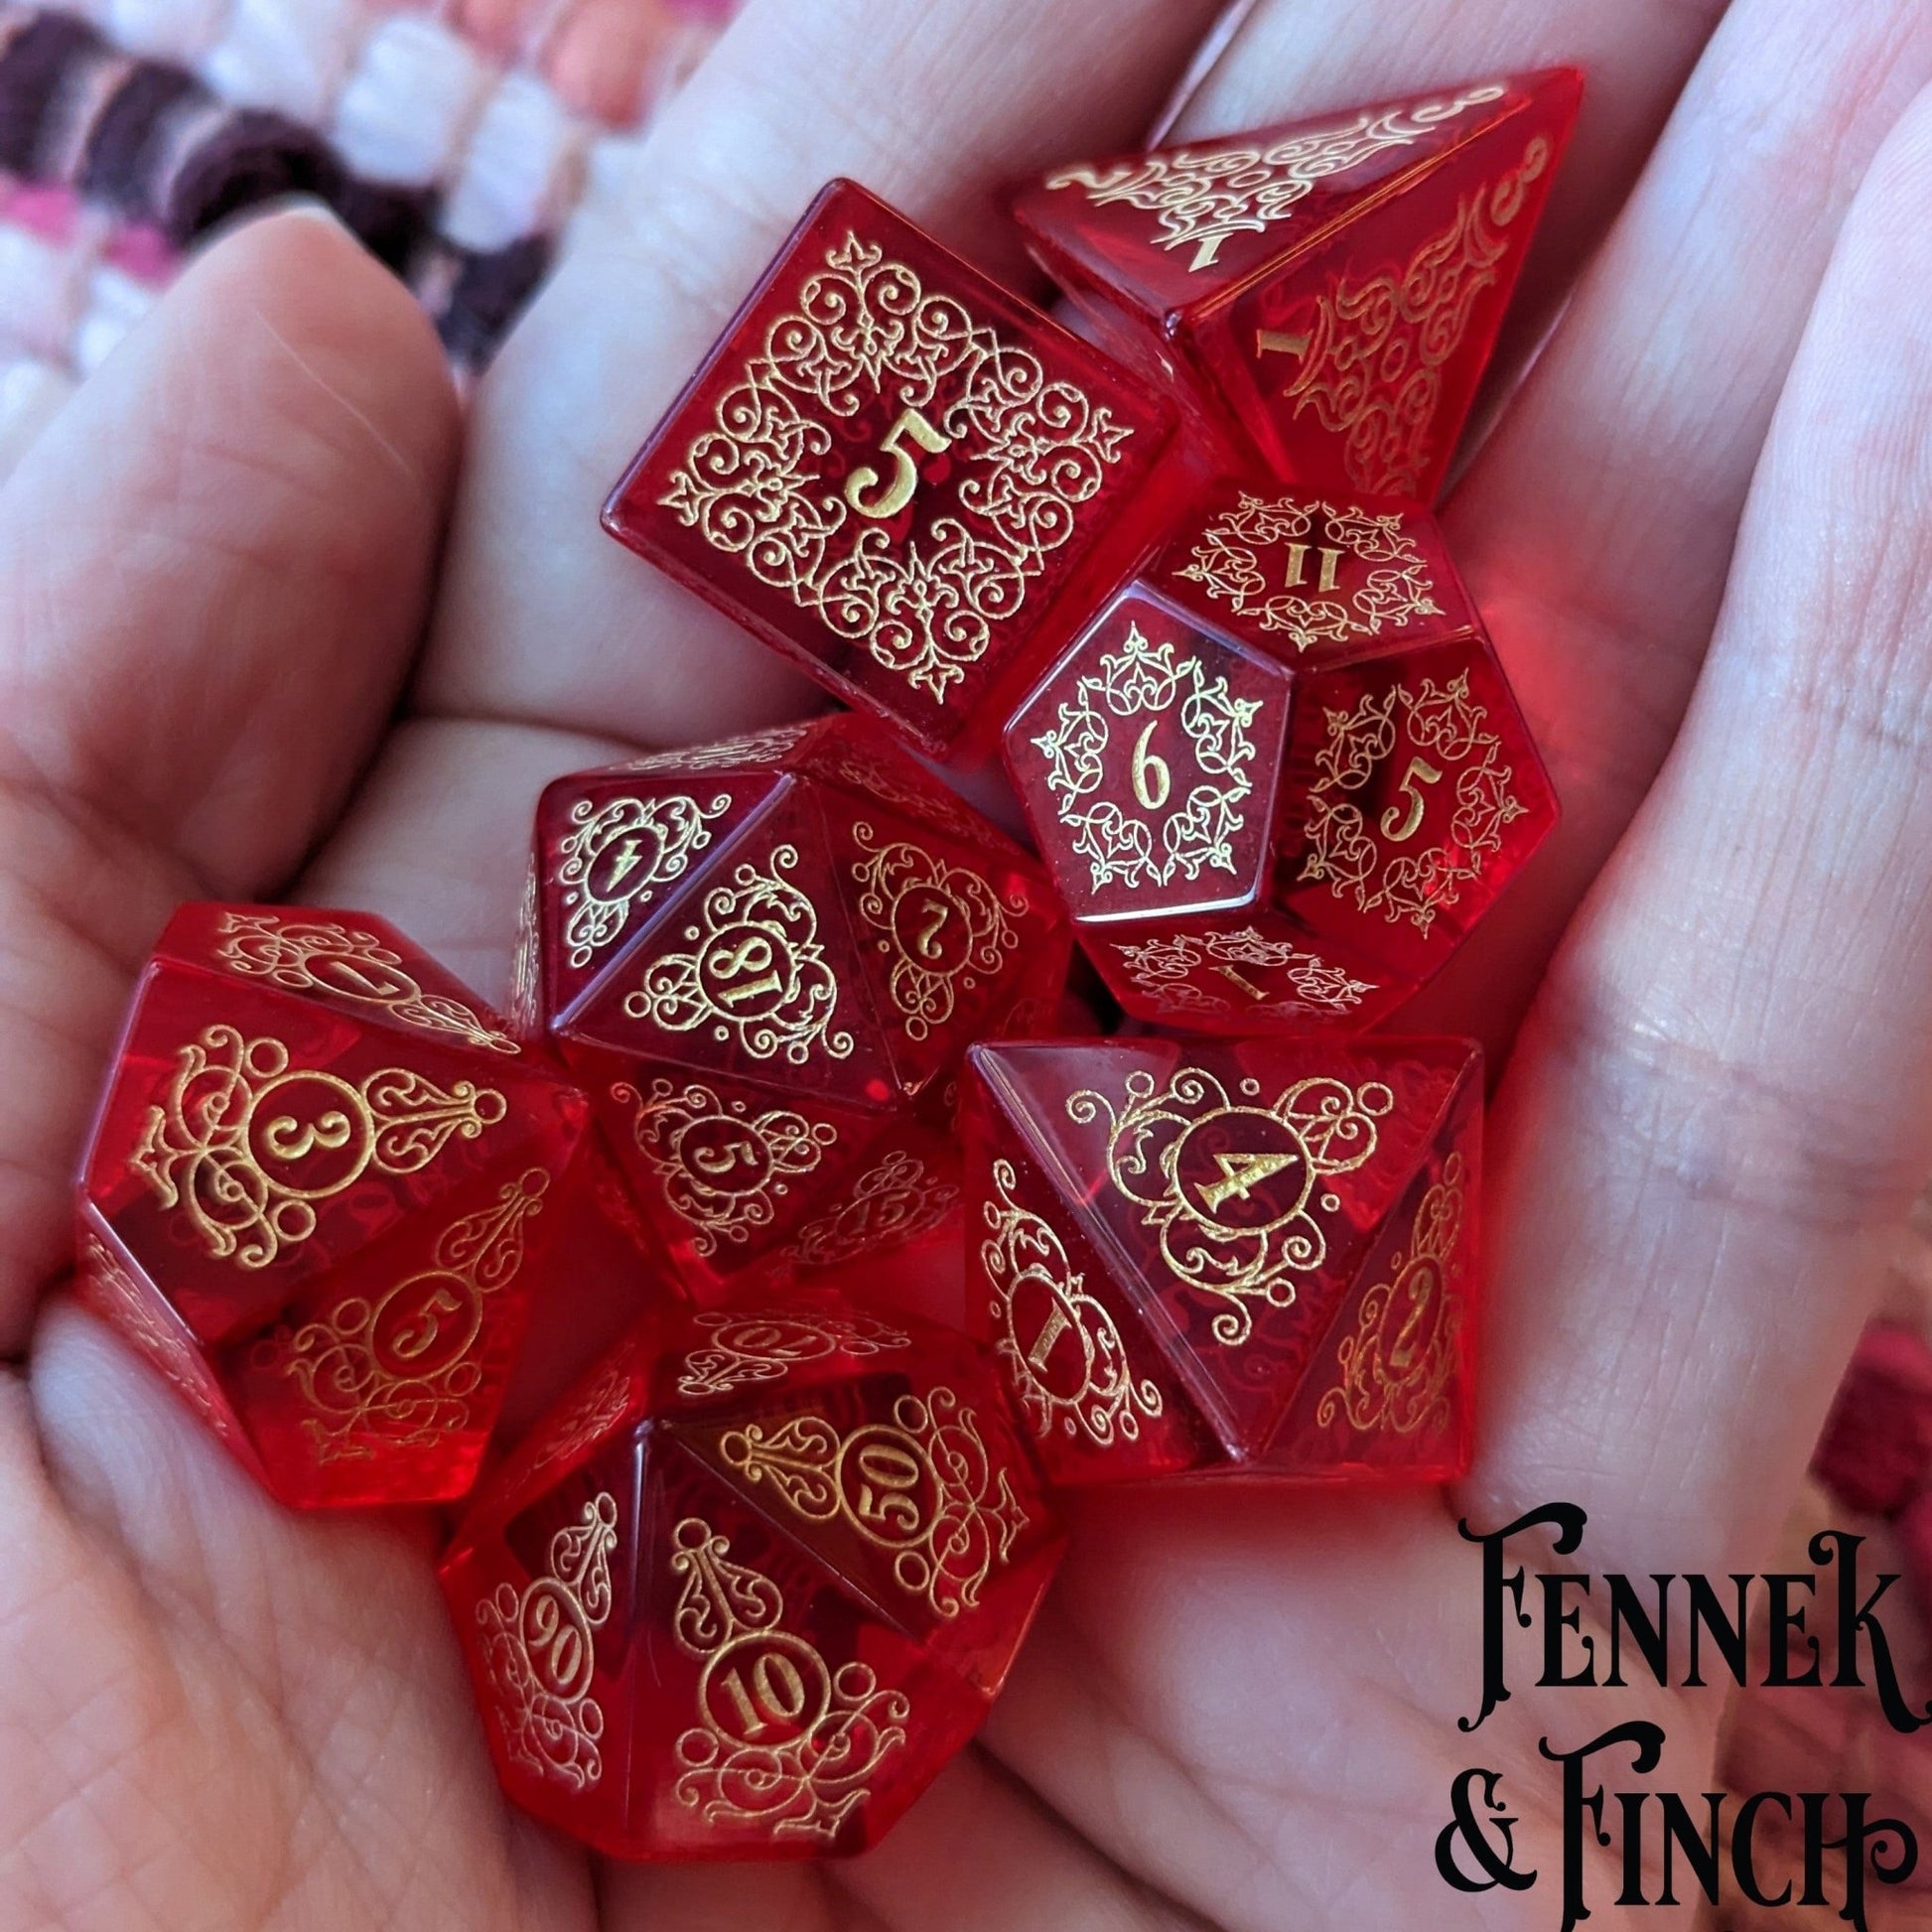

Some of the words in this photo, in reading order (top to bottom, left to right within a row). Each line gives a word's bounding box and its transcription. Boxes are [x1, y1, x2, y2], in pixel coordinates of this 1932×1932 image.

[1188, 232, 1234, 273] 1
[1256, 329, 1313, 364] 1
[844, 409, 952, 519] 5
[1284, 542, 1343, 594] 11
[1131, 721, 1172, 809] 6
[1379, 757, 1443, 842] 5
[709, 936, 783, 1008] 18
[1208, 964, 1270, 1001] 1
[265, 1109, 351, 1159] 3
[693, 1140, 759, 1173] 5
[1194, 1153, 1299, 1214] 4
[391, 1289, 464, 1358] 5
[1027, 1297, 1073, 1373] 1
[1389, 1266, 1434, 1367] 2
[858, 1444, 921, 1531] 50
[528, 1594, 584, 1684] 90
[719, 1652, 806, 1735] 10
